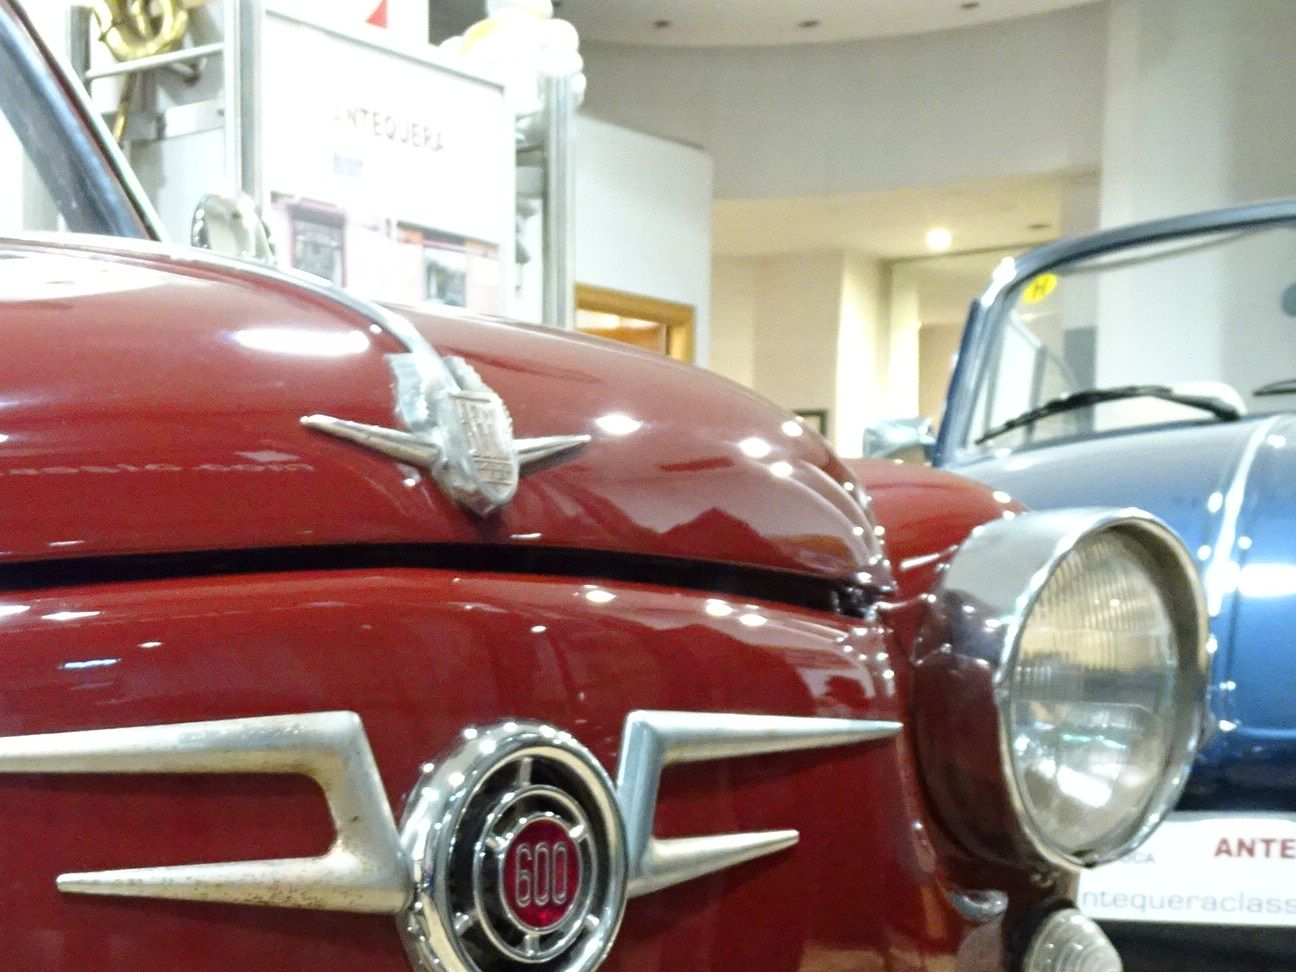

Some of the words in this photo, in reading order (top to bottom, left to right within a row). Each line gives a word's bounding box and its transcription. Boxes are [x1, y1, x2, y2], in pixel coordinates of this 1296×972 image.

[334, 103, 444, 152] NTEQUERA
[1214, 837, 1296, 860] ANTE
[515, 842, 568, 907] 600
